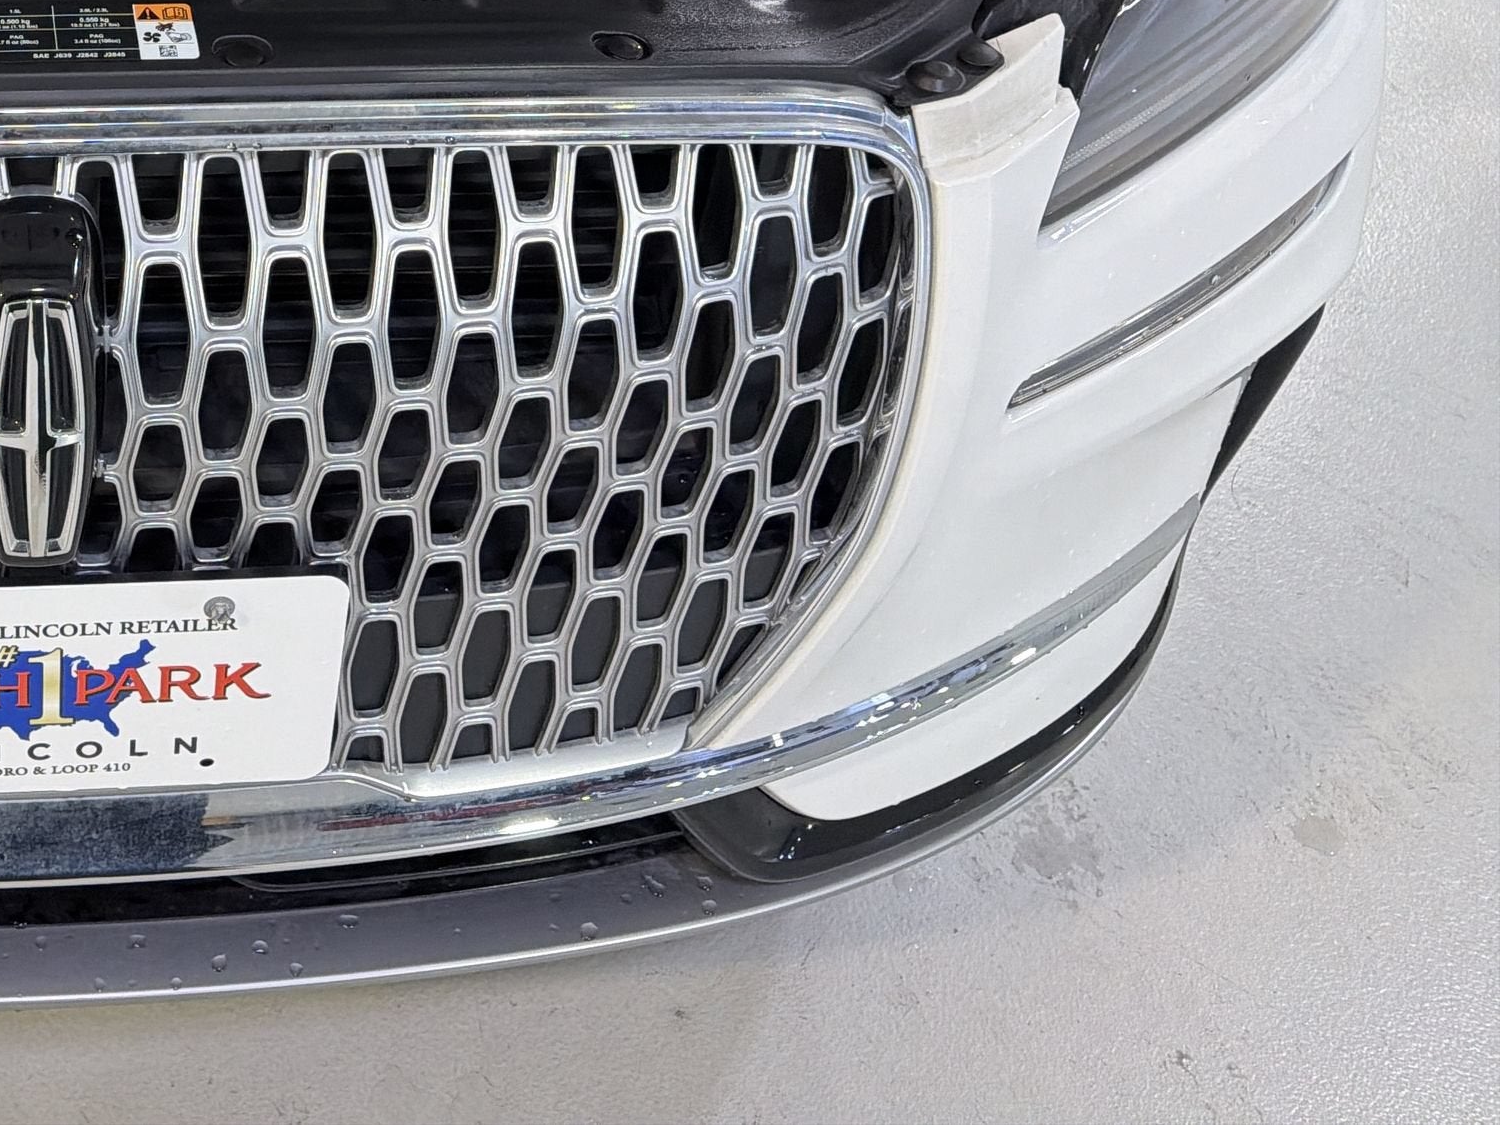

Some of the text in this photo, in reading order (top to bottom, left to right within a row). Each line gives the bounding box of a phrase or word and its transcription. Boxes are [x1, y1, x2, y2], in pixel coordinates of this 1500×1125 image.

[20, 18, 31, 26] kg
[119, 618, 238, 635] RETAILER
[73, 661, 271, 705] PARK
[33, 766, 47, 775] &
[51, 764, 99, 775] LOOP
[102, 762, 131, 773] 410
